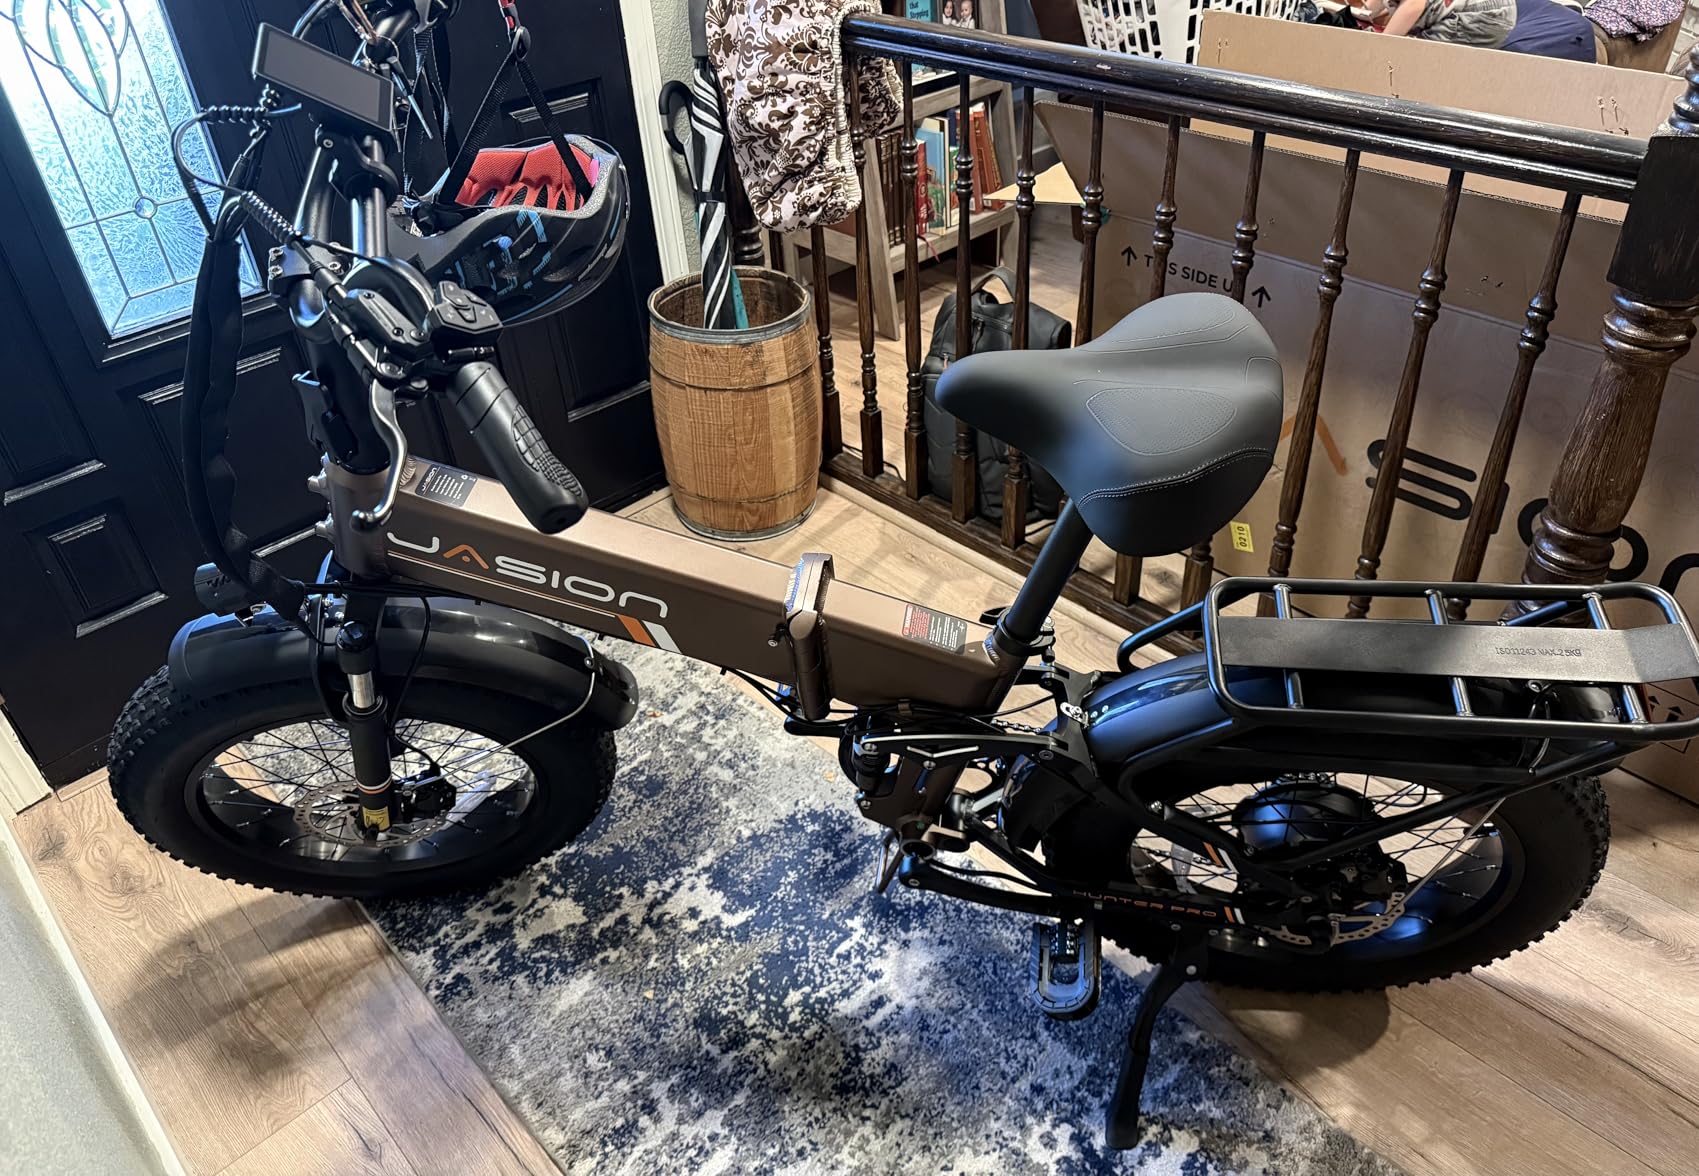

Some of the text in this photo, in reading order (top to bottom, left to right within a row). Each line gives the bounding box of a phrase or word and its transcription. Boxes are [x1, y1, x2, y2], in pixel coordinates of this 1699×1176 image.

[1144, 254, 1234, 292] TS SIDE U
[1237, 526, 1248, 547] 0210
[387, 532, 668, 618] JASION
[1495, 647, 1537, 656] ISO11243
[1073, 889, 1217, 918] HUNTER PRO
